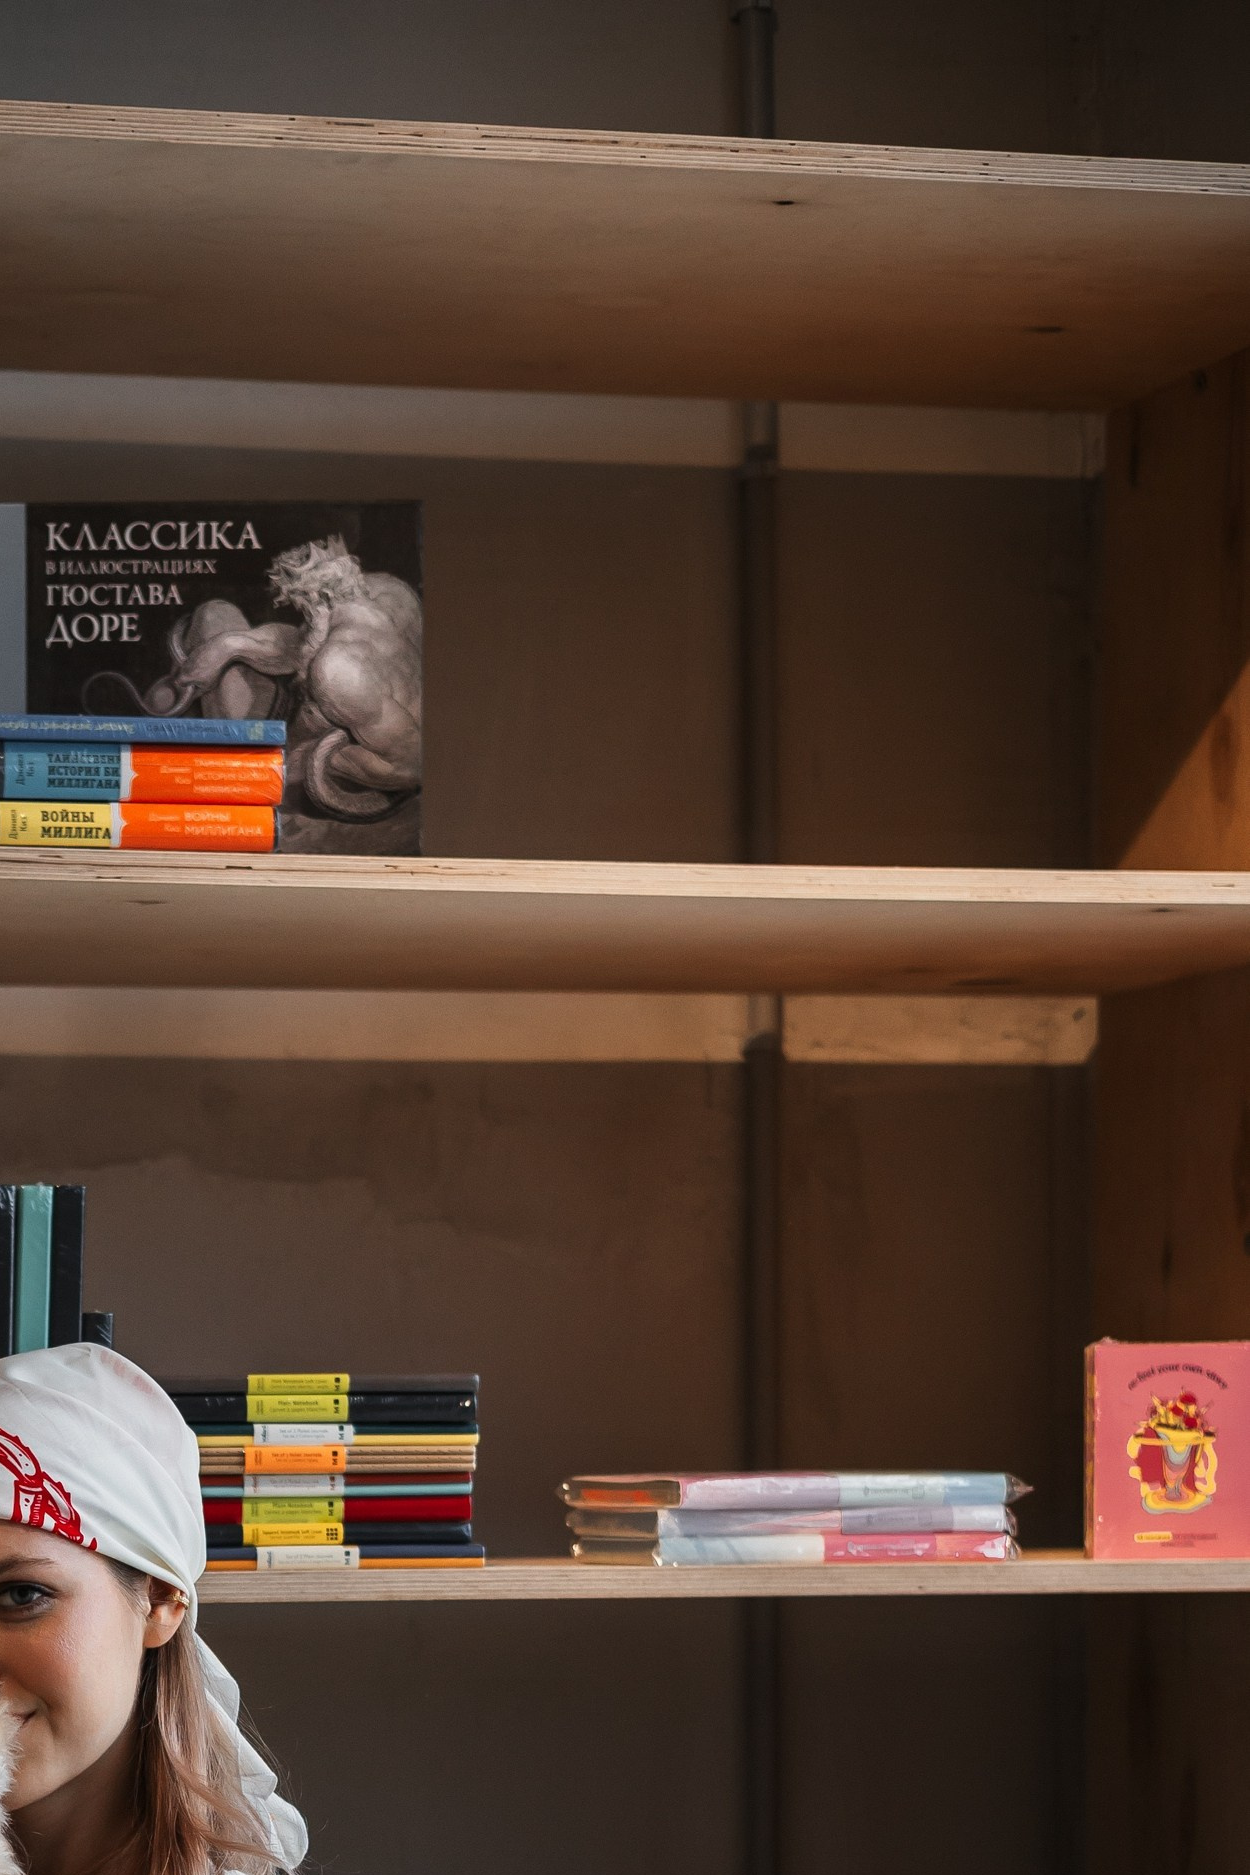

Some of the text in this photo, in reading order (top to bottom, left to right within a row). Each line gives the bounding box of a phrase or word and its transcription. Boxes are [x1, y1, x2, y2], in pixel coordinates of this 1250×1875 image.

[46, 520, 262, 550] КЛАССИКА
[46, 559, 217, 576] В ИЛЛЮСТРАЦИЯХ
[47, 584, 183, 606] ГЮСТАВА
[45, 612, 142, 649] ДОРЕ
[47, 766, 100, 777] ИСТОРИЯ
[41, 810, 94, 824] ВОЙНЫ
